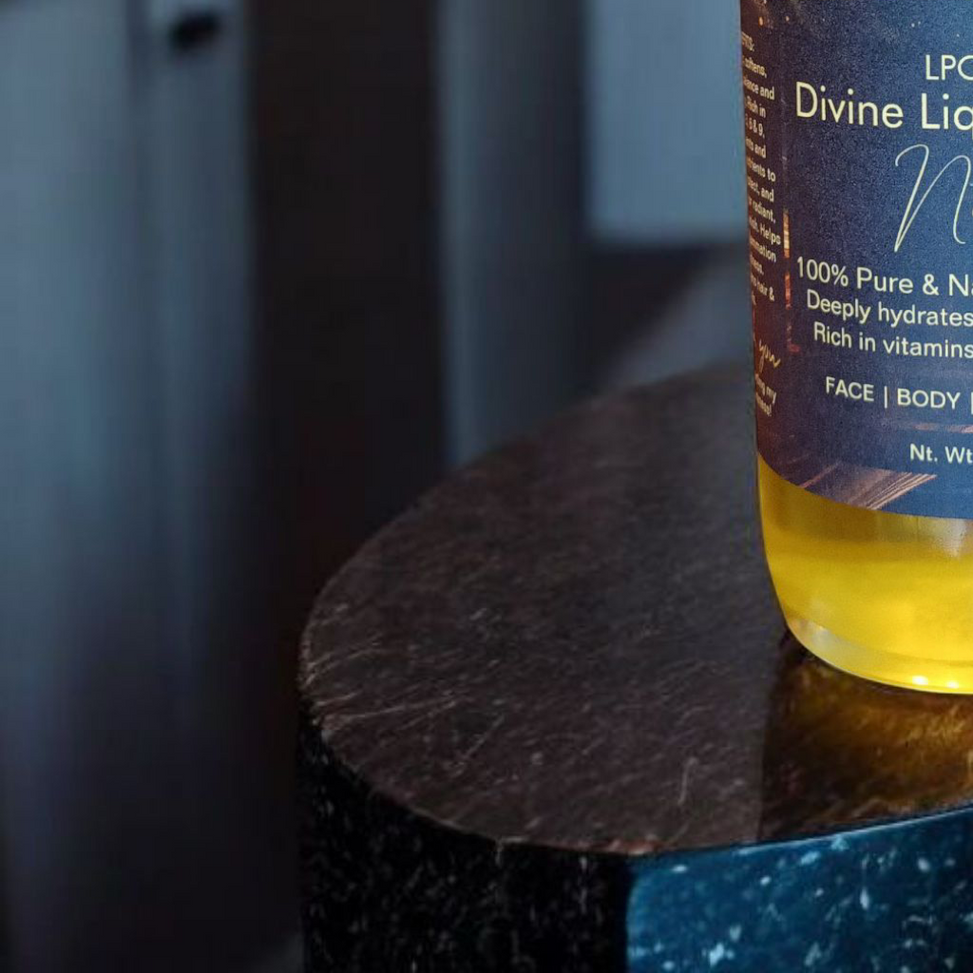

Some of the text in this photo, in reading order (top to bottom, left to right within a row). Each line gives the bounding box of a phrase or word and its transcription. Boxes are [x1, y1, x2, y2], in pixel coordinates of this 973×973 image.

[760, 86, 775, 101] and
[796, 80, 904, 129] Divine
[767, 167, 776, 182] to
[761, 187, 775, 203] and
[759, 223, 781, 245] Helps
[797, 256, 849, 288] 100%
[856, 267, 914, 294] Pure
[922, 274, 940, 296] &
[806, 288, 871, 324] Deeply
[813, 320, 852, 349] Rich
[858, 331, 876, 352] in
[825, 376, 875, 403] FACE
[897, 388, 961, 410] BODY
[910, 444, 938, 464] Nt.
